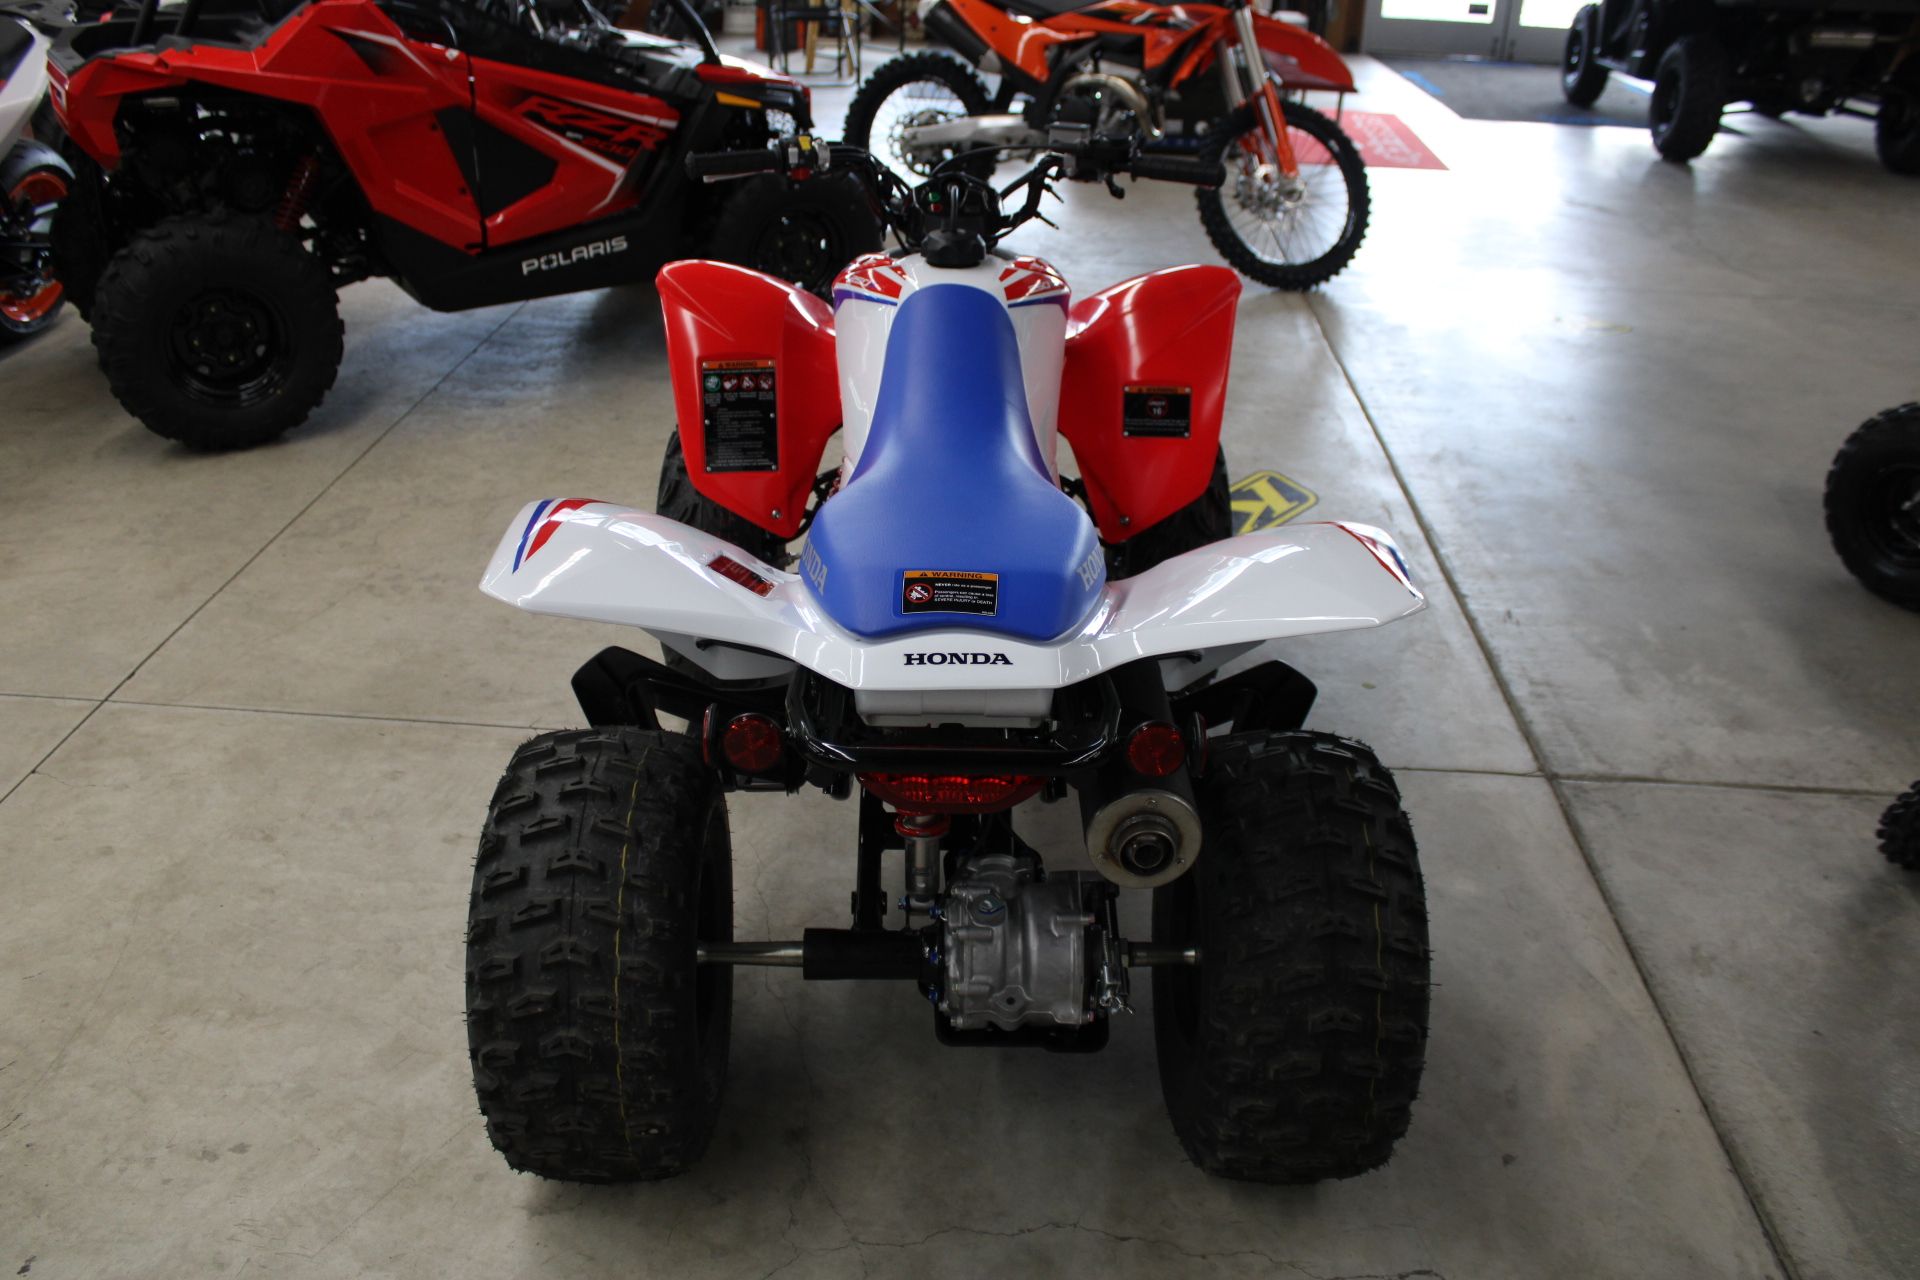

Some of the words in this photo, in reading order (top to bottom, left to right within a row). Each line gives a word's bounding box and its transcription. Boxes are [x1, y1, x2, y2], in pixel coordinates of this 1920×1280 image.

[515, 96, 668, 149] RZR
[522, 235, 628, 275] POLARIS
[931, 571, 983, 579] WARNING
[903, 652, 1014, 666] HONDA
